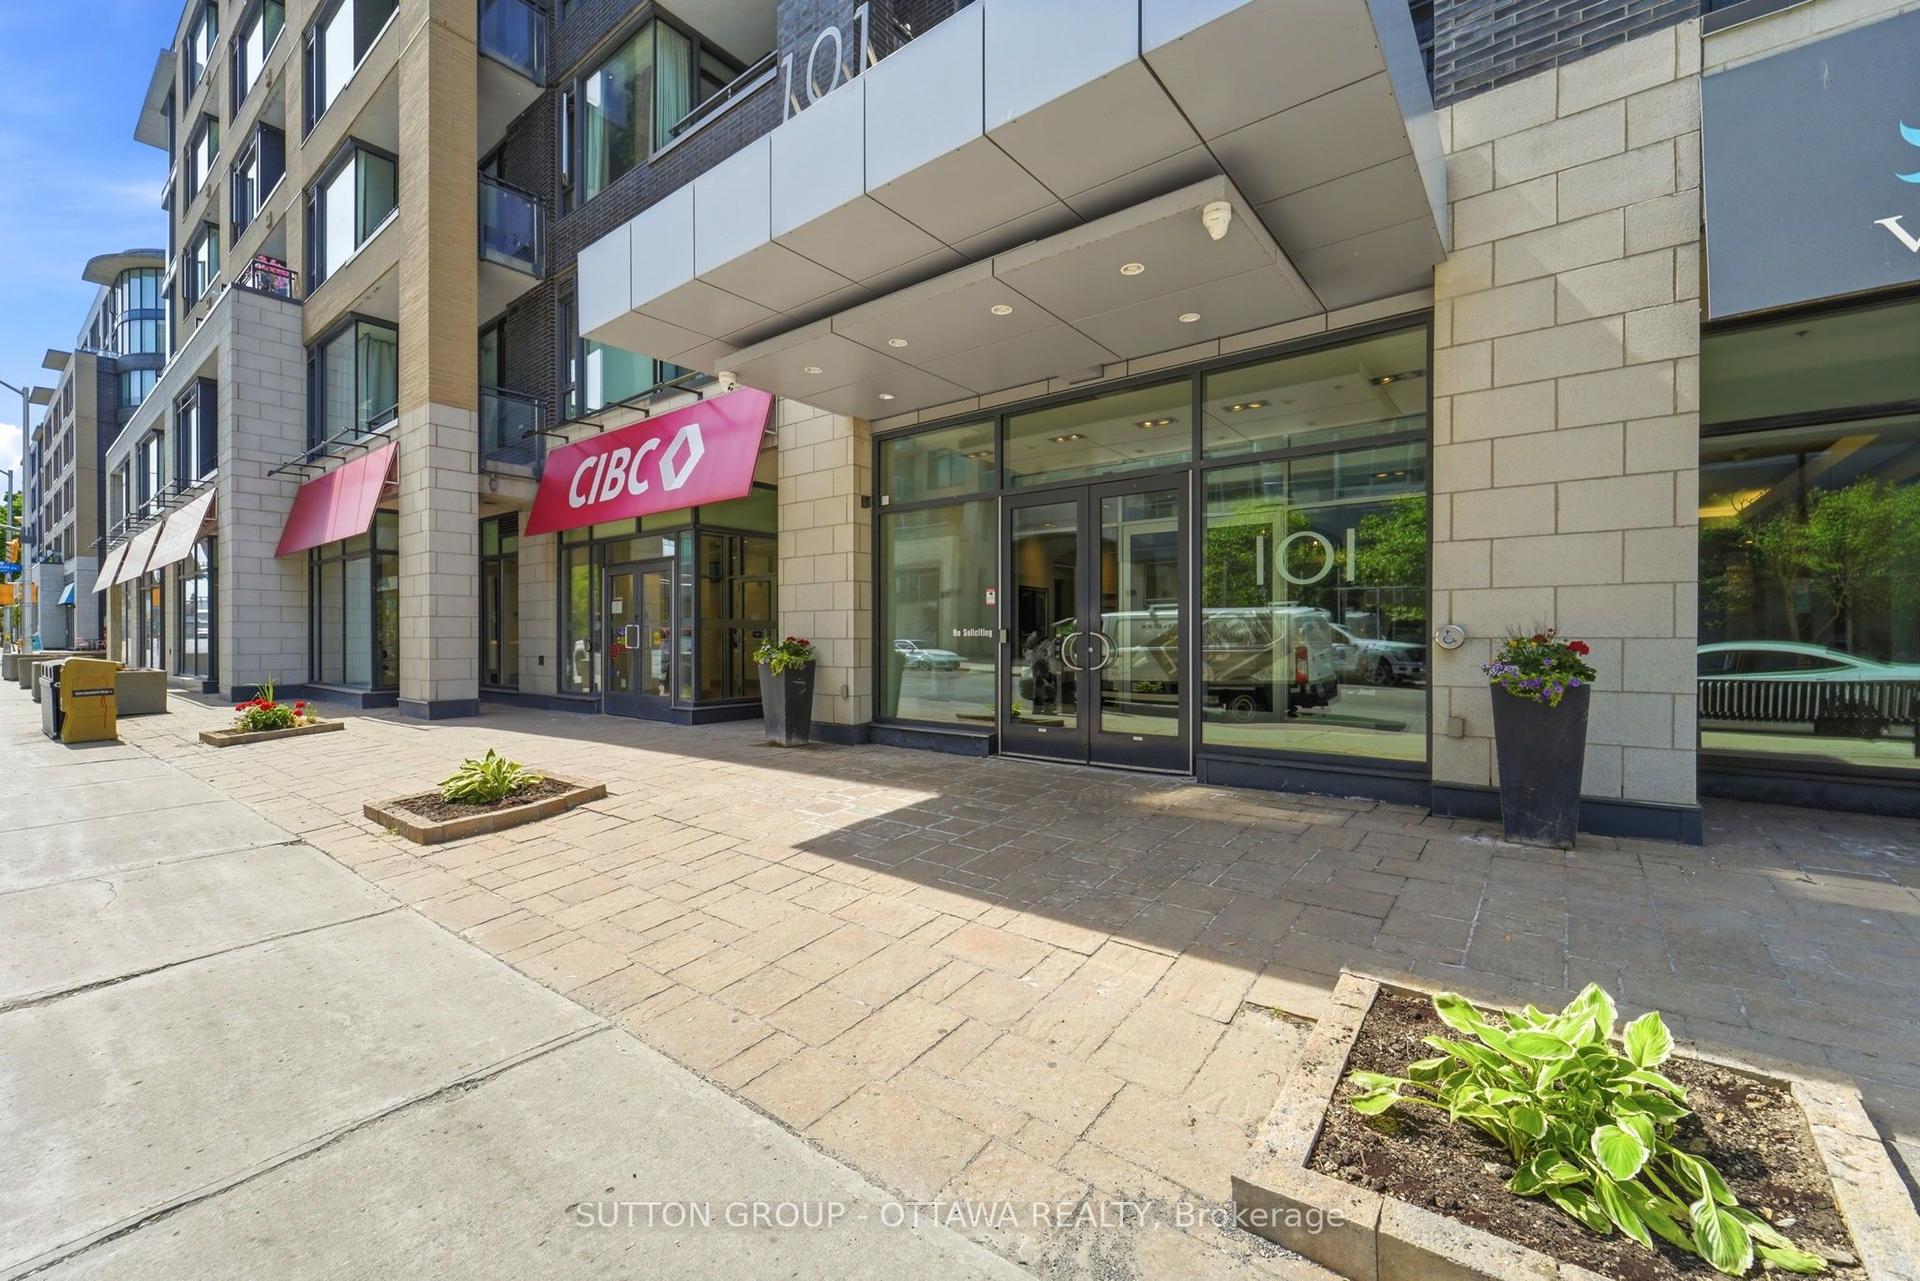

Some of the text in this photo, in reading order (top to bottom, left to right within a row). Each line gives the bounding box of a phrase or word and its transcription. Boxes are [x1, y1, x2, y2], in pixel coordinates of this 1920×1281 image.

[780, 1, 870, 122] 101
[568, 437, 661, 509] CIBC
[1256, 527, 1356, 586] 101
[953, 628, 993, 638] No Soliciting
